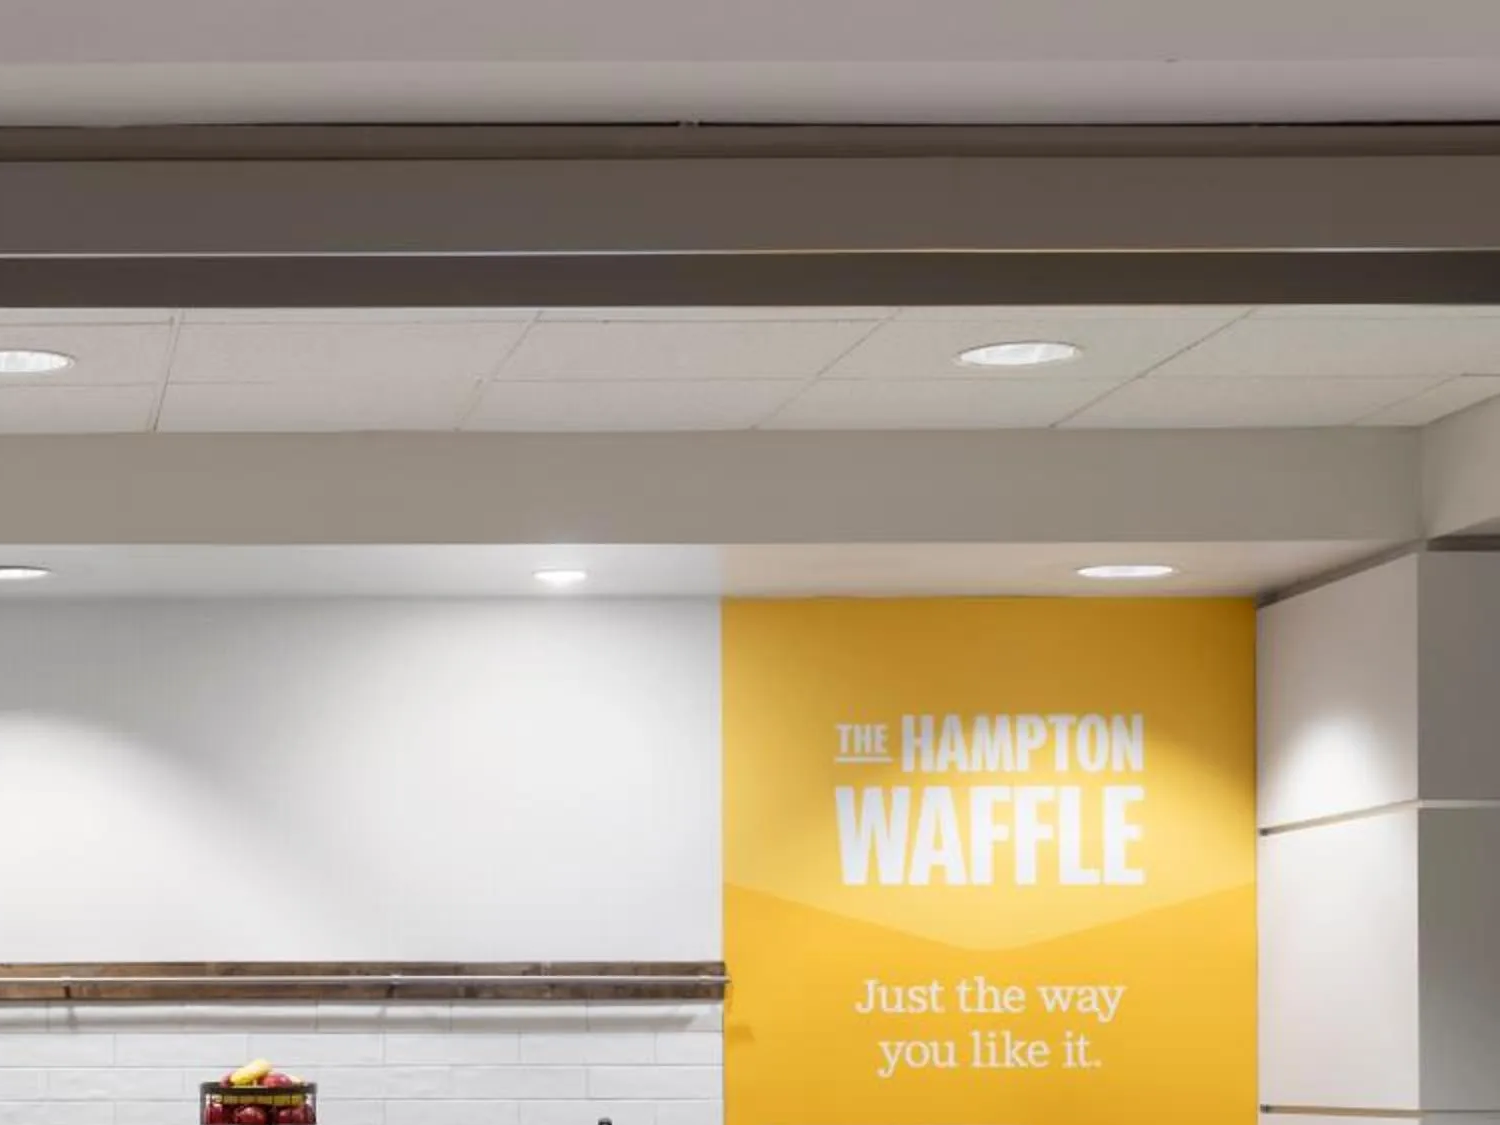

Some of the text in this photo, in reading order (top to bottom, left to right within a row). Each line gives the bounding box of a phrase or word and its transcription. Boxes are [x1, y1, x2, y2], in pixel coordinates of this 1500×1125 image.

[835, 714, 1144, 772] THE HAMPTON
[835, 785, 1146, 886] WAFFLE
[855, 976, 1127, 1022] Just the way
[877, 1030, 1103, 1078] you like it.
